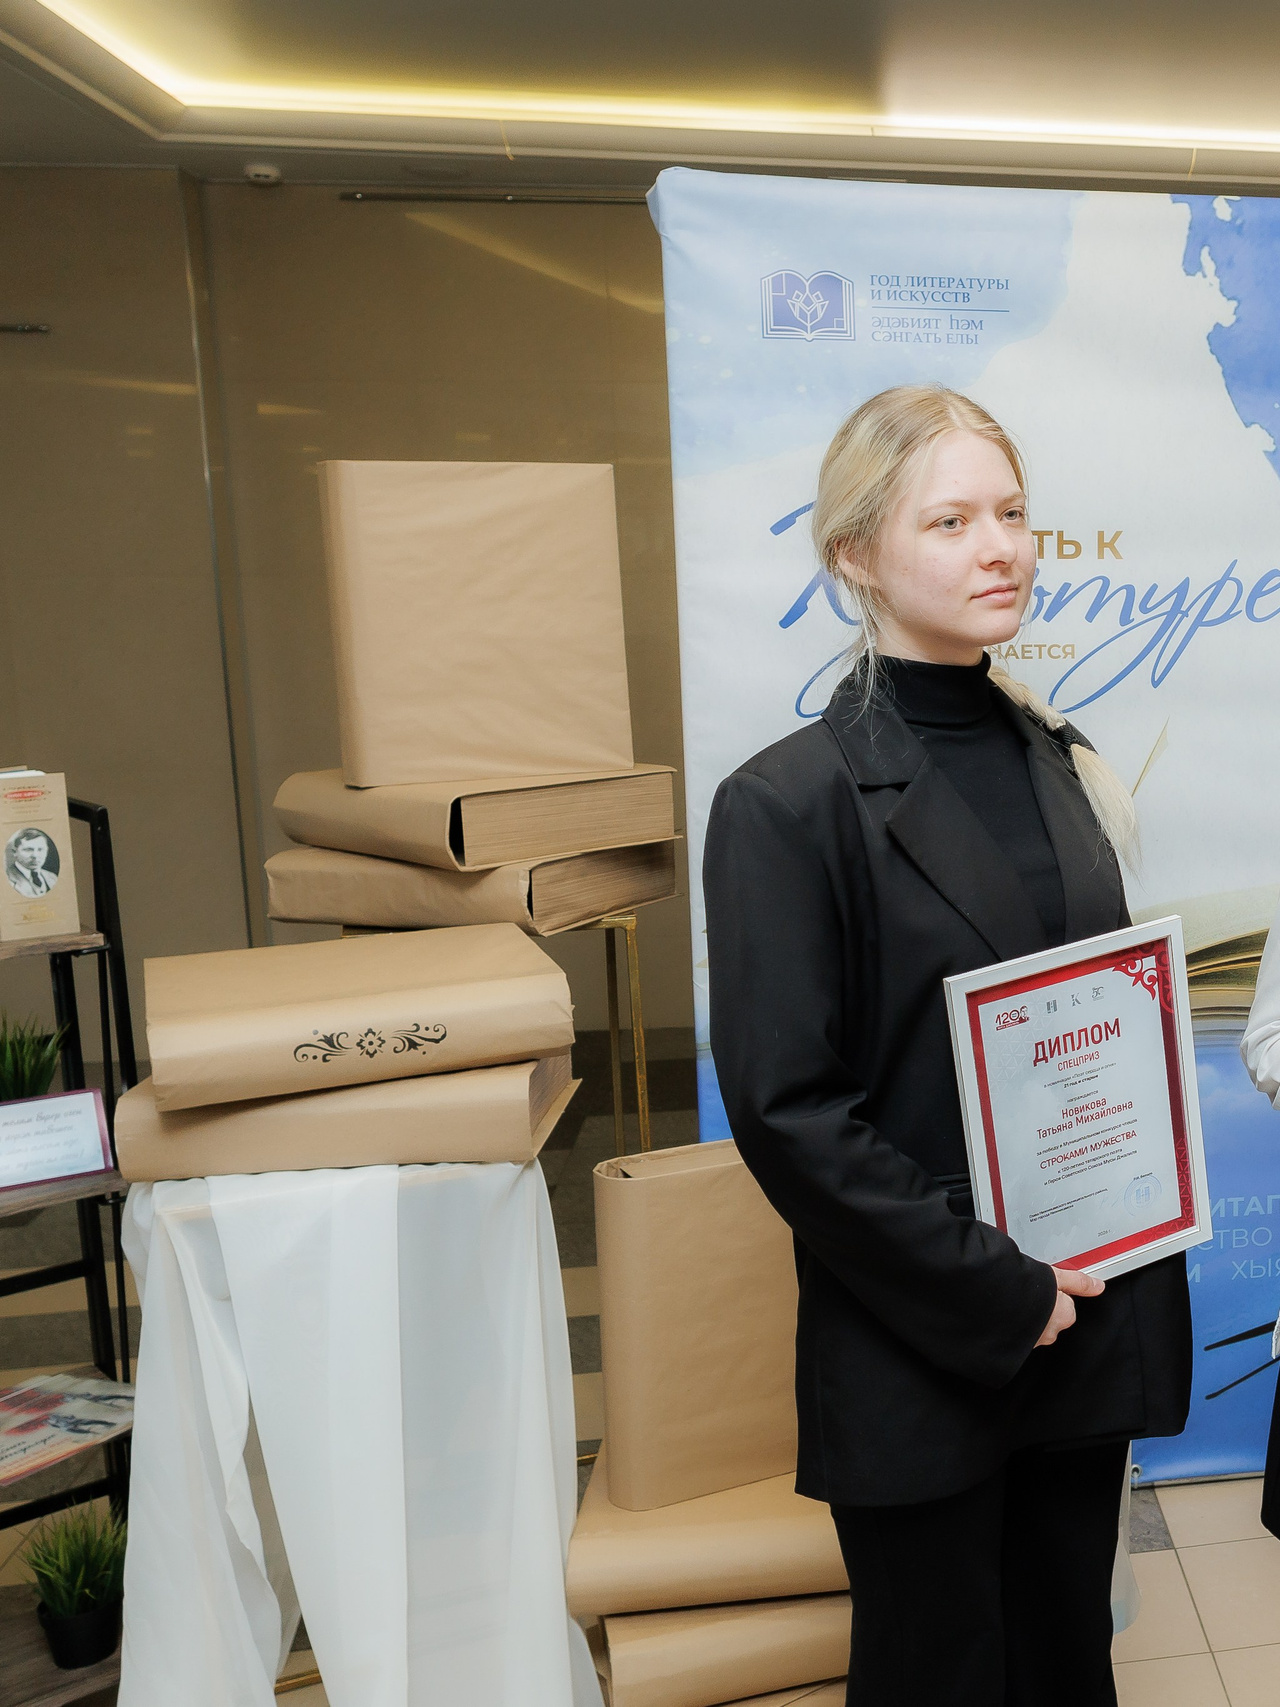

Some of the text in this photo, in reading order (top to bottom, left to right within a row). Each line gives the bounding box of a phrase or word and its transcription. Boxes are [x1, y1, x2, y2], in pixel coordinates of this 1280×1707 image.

[870, 274, 1010, 291] ГОД ЛИТЕРАТУРЫ
[871, 289, 971, 304] И ИСКУССТВ
[871, 315, 941, 331] ӘДӘБИЯТ
[871, 331, 979, 345] СӘНГАТЬ ЕЛЫ
[1031, 530, 1123, 560] ТЬ К
[988, 643, 1075, 660] НАЕТСЯ
[1033, 1017, 1121, 1067] ДИПЛОМ
[1057, 1050, 1100, 1072] СПЕЦПРИЗ
[1067, 1090, 1099, 1103] награждается
[1037, 1100, 1133, 1139] Татьяна Михайловна
[1061, 1098, 1107, 1119] Новикова
[1042, 1145, 1059, 1155] победу
[1063, 1129, 1100, 1147] Муниципальном
[1101, 1123, 1122, 1134] конкурсе
[1122, 1118, 1138, 1127] чтецов
[1040, 1129, 1137, 1170] СТРОКАМИ МУЖЕСТВА
[1061, 1161, 1085, 1173] 120-летию
[1085, 1153, 1110, 1164] татарского
[1110, 1148, 1123, 1156] поэта
[1048, 1176, 1061, 1185] Героя
[1062, 1167, 1088, 1180] Советского
[1088, 1162, 1103, 1170] Союза
[1104, 1157, 1117, 1166] Мусы
[1117, 1149, 1138, 1161] Джалиля
